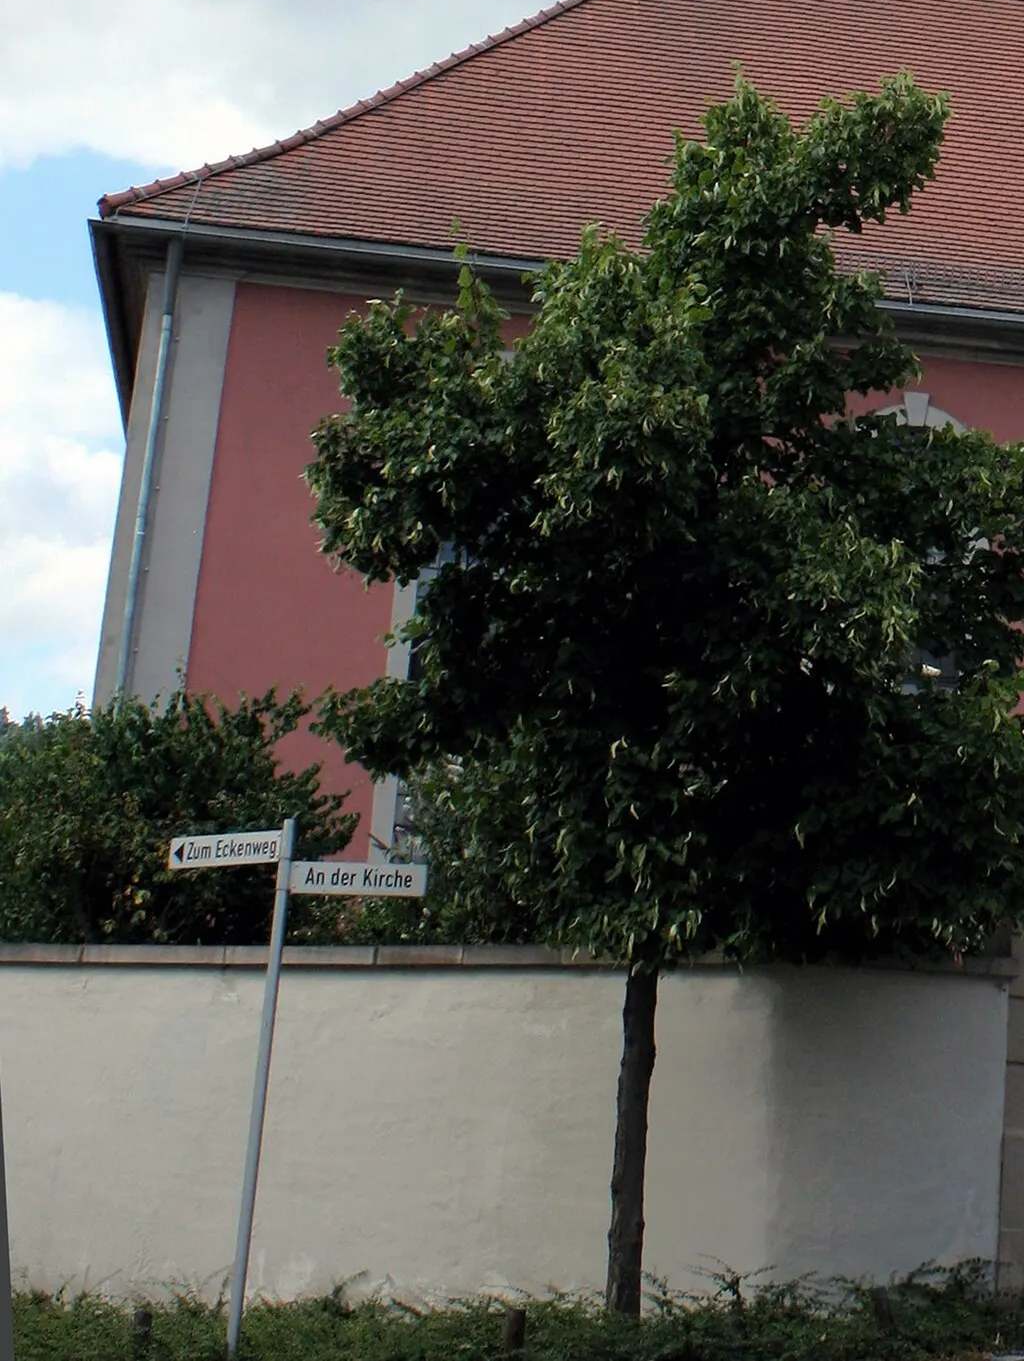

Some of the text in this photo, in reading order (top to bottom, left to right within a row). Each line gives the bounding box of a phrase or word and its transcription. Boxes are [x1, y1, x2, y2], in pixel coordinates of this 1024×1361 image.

[186, 834, 277, 859] Zum Eckenweg
[305, 867, 413, 888] An der Kirche
